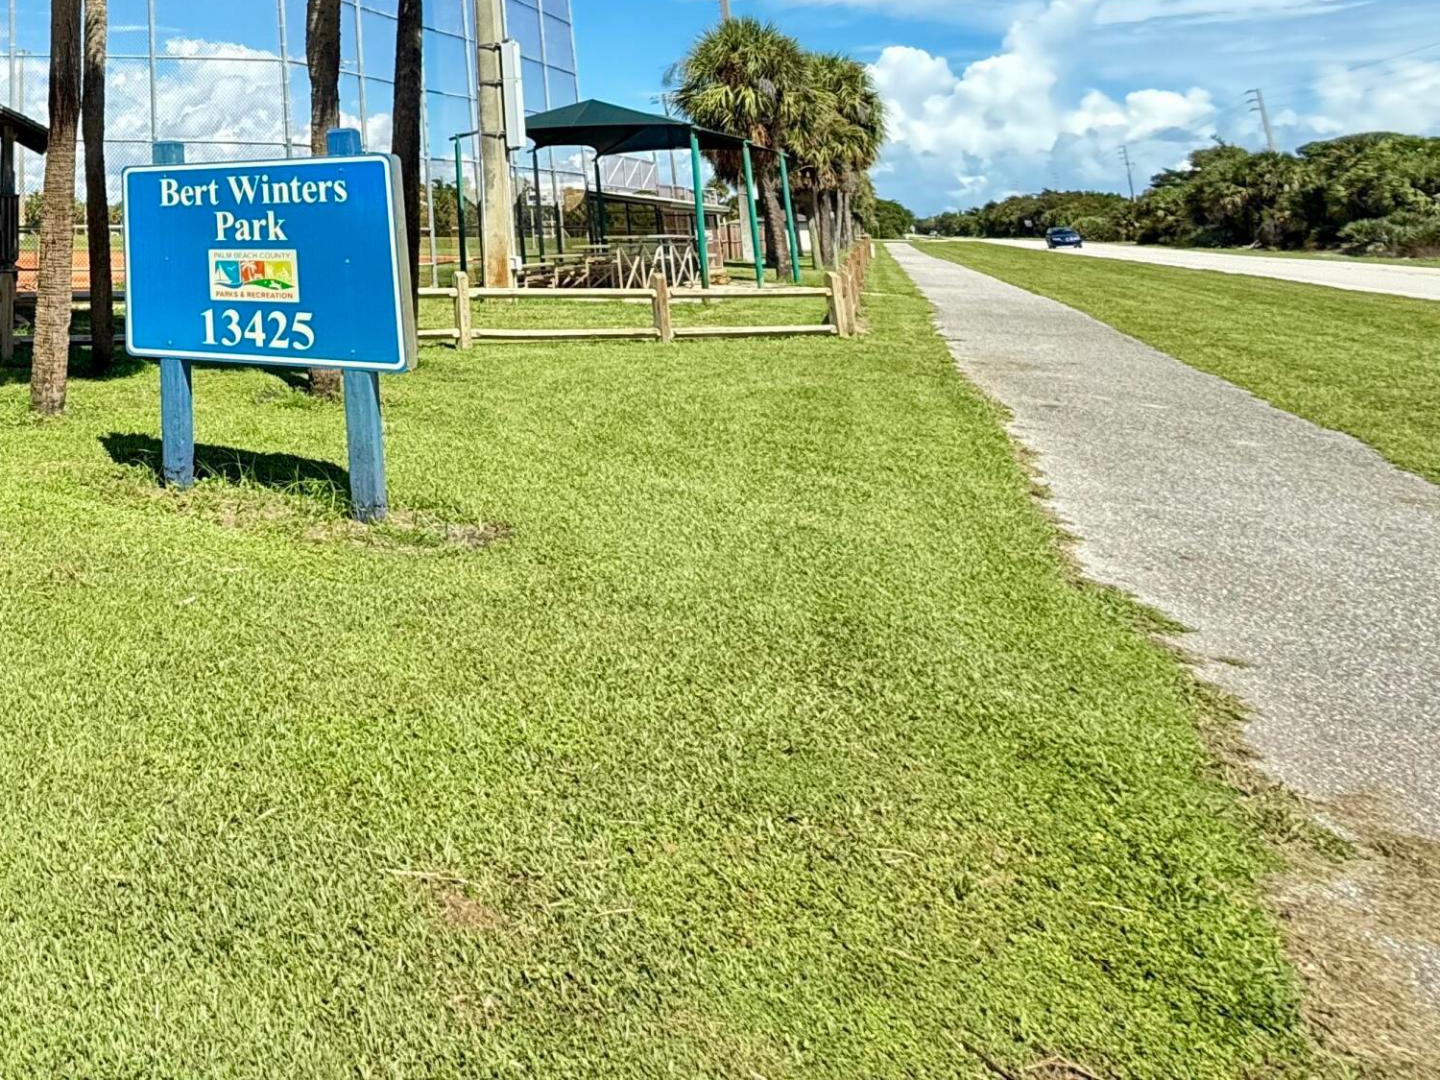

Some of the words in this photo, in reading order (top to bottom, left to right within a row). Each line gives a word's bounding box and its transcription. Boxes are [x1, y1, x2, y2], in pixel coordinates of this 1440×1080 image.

[159, 178, 219, 206] Bert
[227, 175, 347, 205] Winters
[214, 210, 288, 241] Park
[247, 291, 293, 299] RECREATION
[200, 308, 315, 350] 13425
